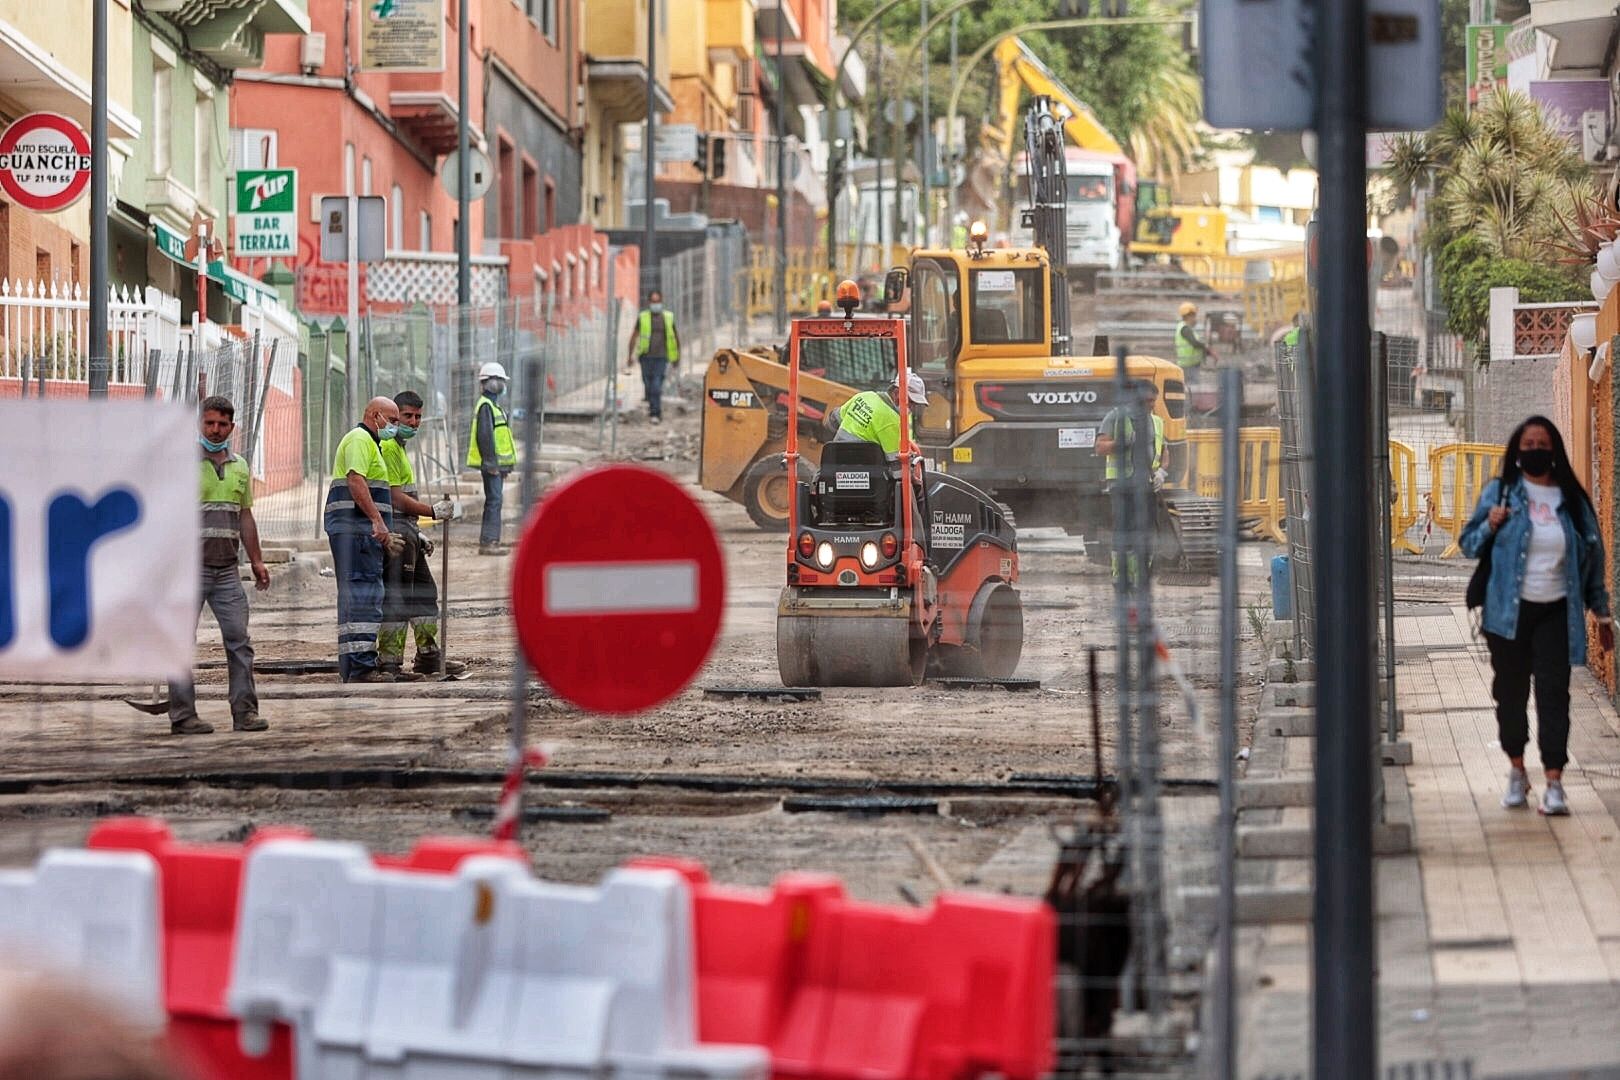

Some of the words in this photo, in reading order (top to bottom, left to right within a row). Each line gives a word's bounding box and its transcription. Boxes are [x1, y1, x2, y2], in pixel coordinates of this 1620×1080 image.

[14, 145, 36, 153] AUTO
[38, 145, 76, 153] ESCUELA
[0, 155, 90, 170] GUANCHE
[254, 217, 279, 230] BAR
[240, 234, 289, 250] TERRAZA
[731, 391, 753, 406] CAT
[1027, 391, 1097, 404] VOLVO
[945, 514, 971, 523] HAMM
